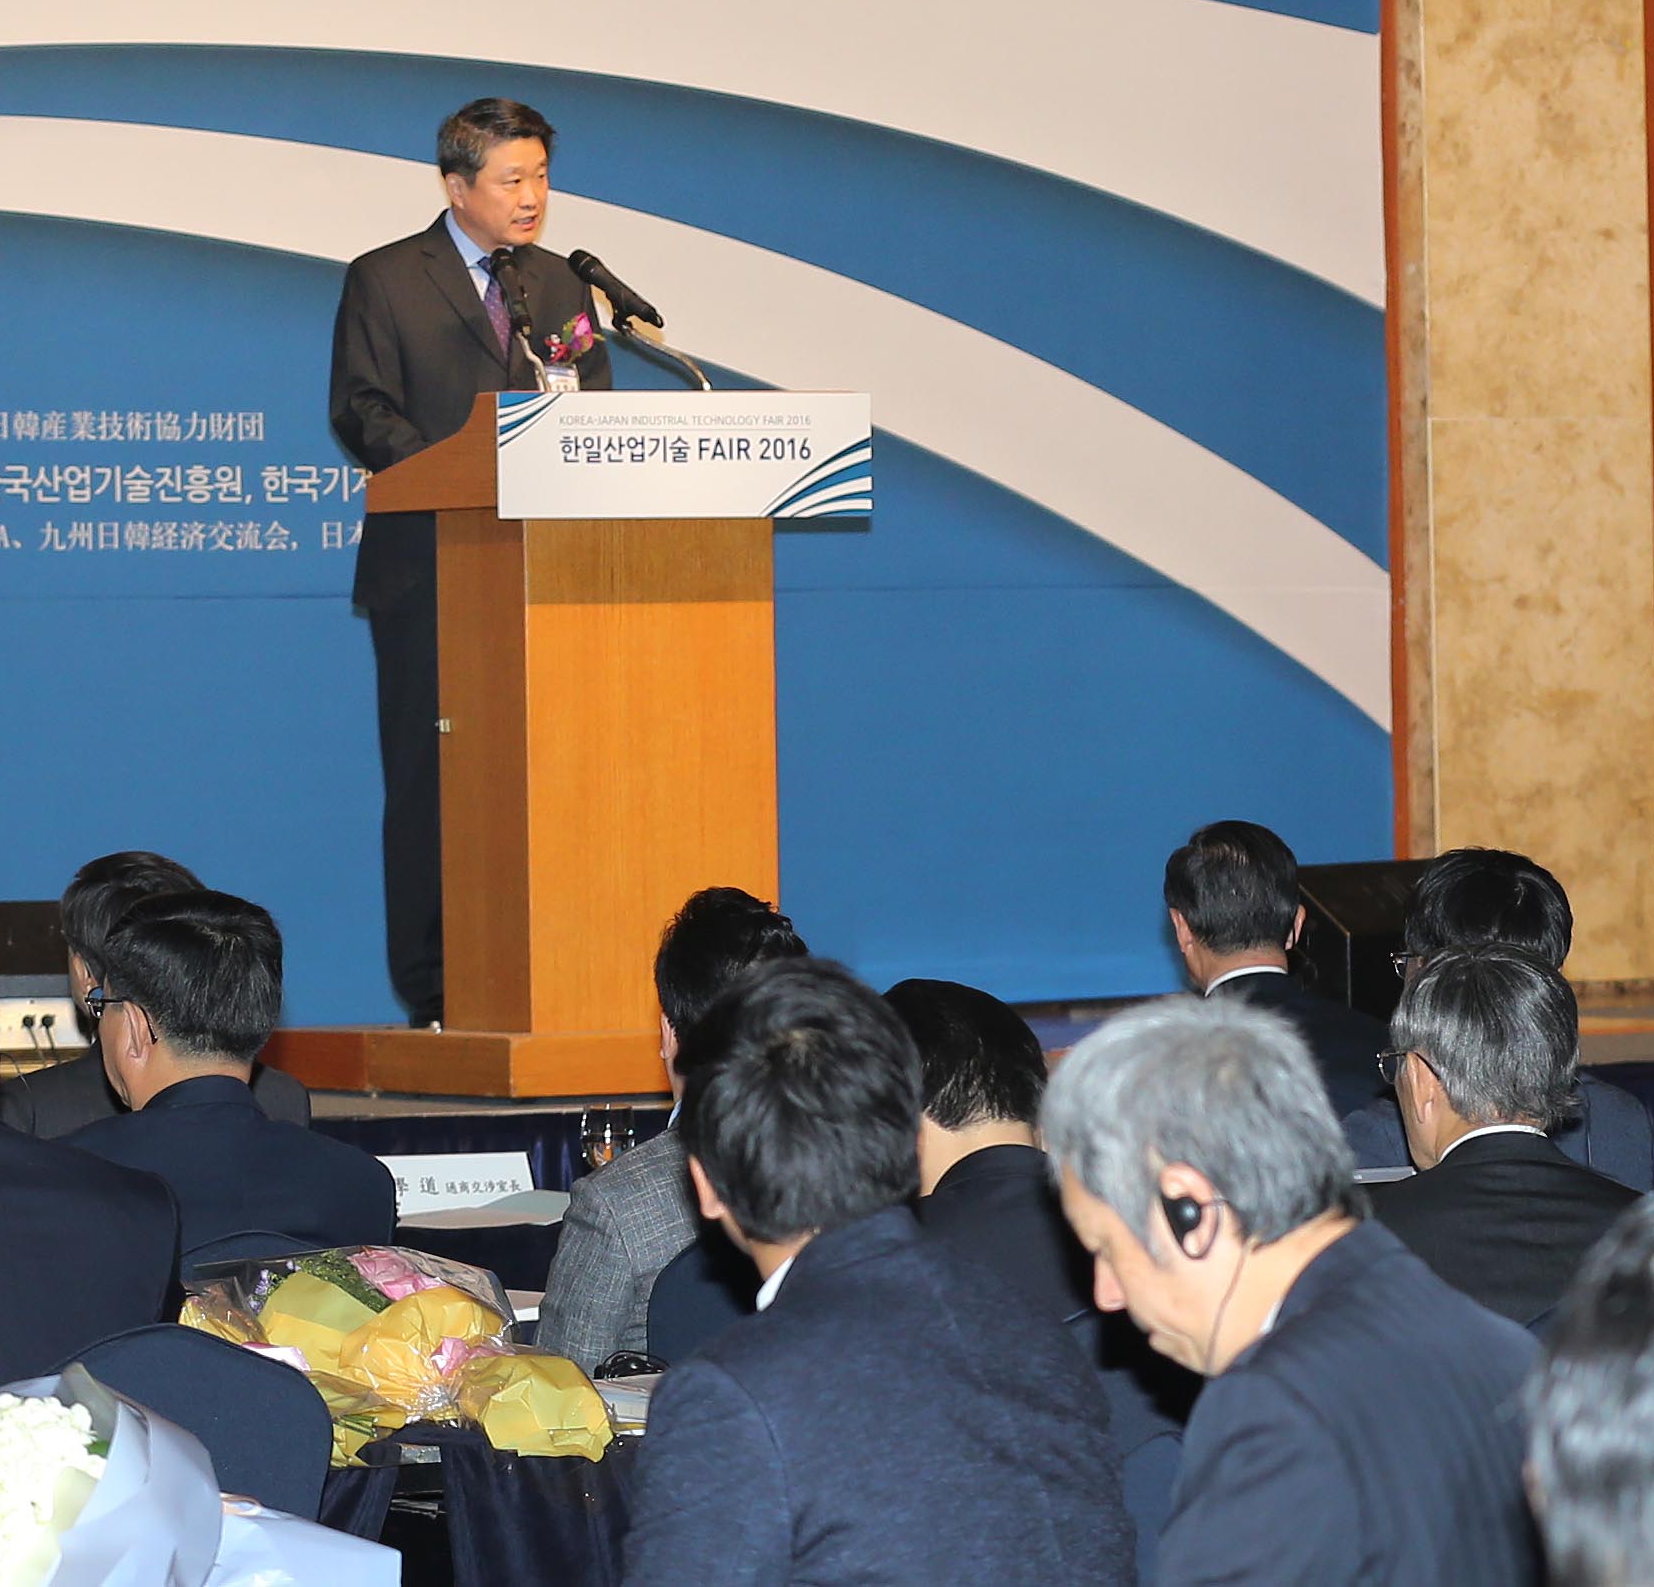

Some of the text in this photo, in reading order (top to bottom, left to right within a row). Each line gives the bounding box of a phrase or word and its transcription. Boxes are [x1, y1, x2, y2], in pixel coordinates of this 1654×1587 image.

[559, 415, 812, 426] KOREA-JAPAN INDUSTRIAL TECHNOLOGY FAIR 2016
[560, 435, 812, 464] 한일산업기술 FAIR 2016
